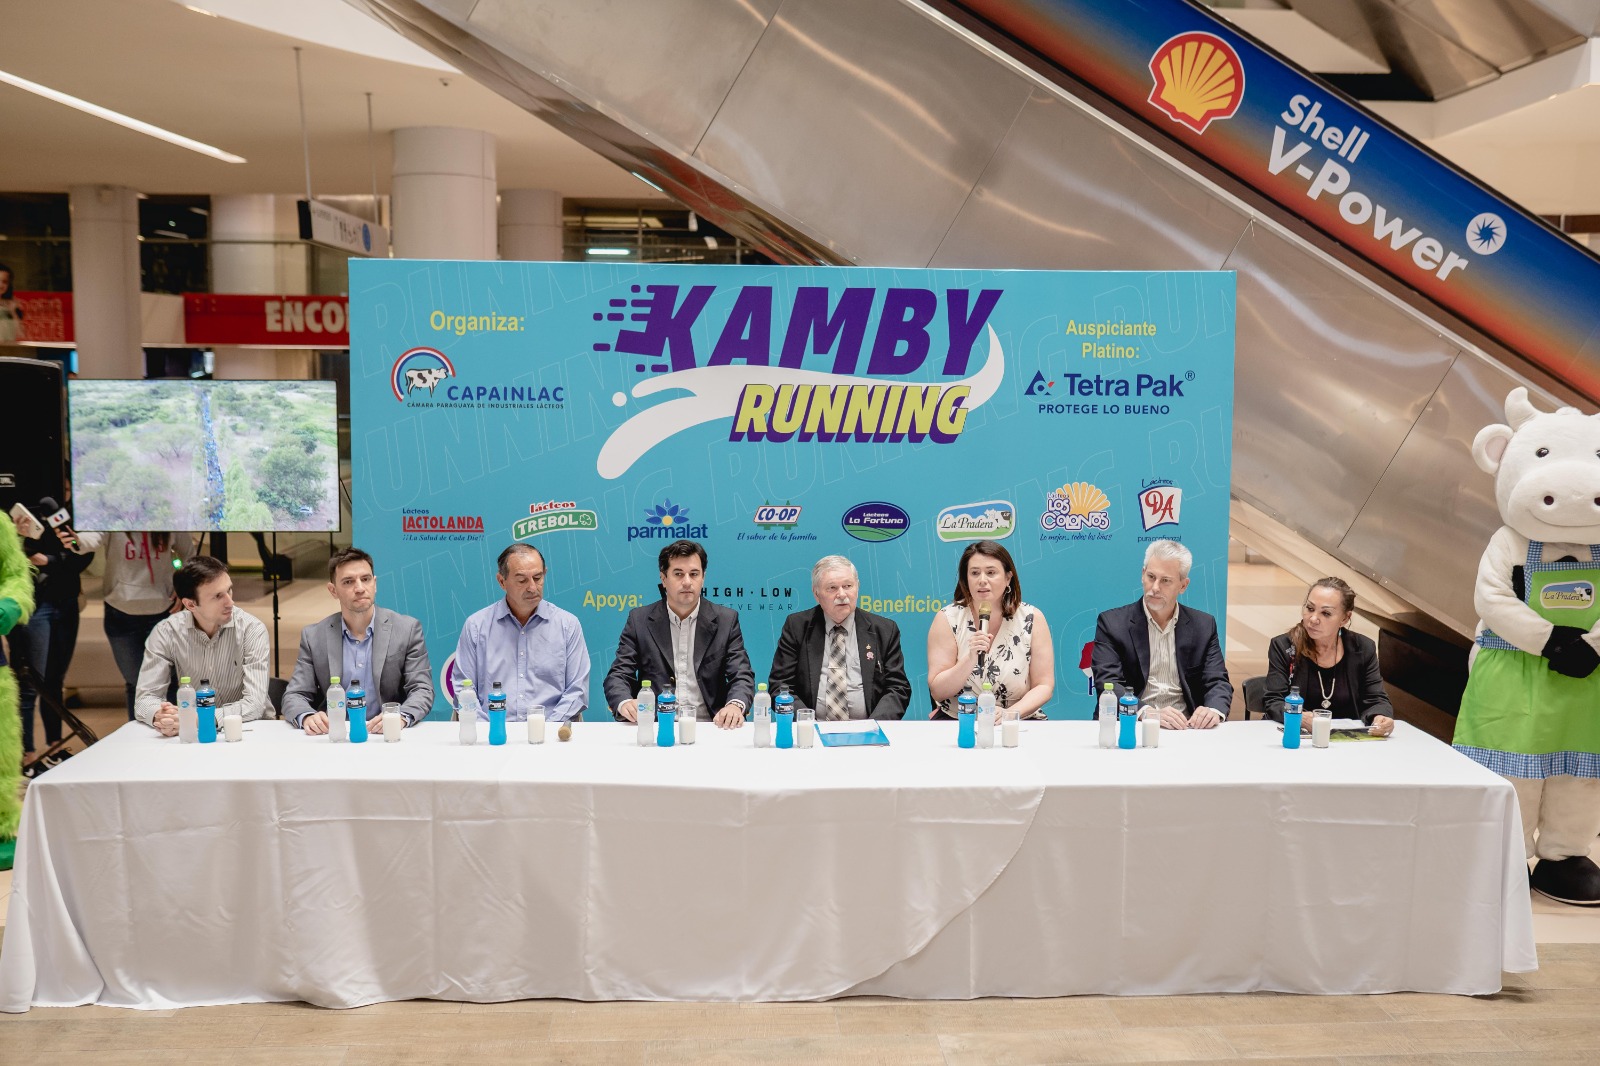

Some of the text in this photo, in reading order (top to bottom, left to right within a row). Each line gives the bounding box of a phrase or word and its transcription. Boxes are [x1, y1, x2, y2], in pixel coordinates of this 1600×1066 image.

[1281, 94, 1370, 164] Shell
[1267, 124, 1469, 283] V-Power
[264, 301, 349, 334] ENCO
[430, 310, 525, 335] Organiza:
[615, 284, 1004, 376] KAMBY
[1065, 320, 1157, 339] Auspiciante
[1082, 342, 1140, 358] Platino:
[447, 386, 564, 401] CAPAINLAC
[1064, 373, 1130, 397] Tetra
[407, 400, 434, 408] CÁMARA
[728, 383, 971, 444] RUNNING
[1038, 404, 1170, 415] PROTEGE LO BUENO
[757, 508, 798, 521] CO-OP
[1047, 498, 1070, 515] LOS
[402, 515, 485, 533] LACTOLANDA
[517, 513, 579, 536] TREBOL
[941, 516, 994, 529] La Pradera
[1041, 511, 1110, 530] COLONOS
[627, 523, 709, 542] parmalat
[737, 532, 817, 543] El sabor de la familia
[582, 590, 643, 612] Apoya:
[759, 603, 793, 611] WEAR
[860, 595, 947, 613] Beneficio:
